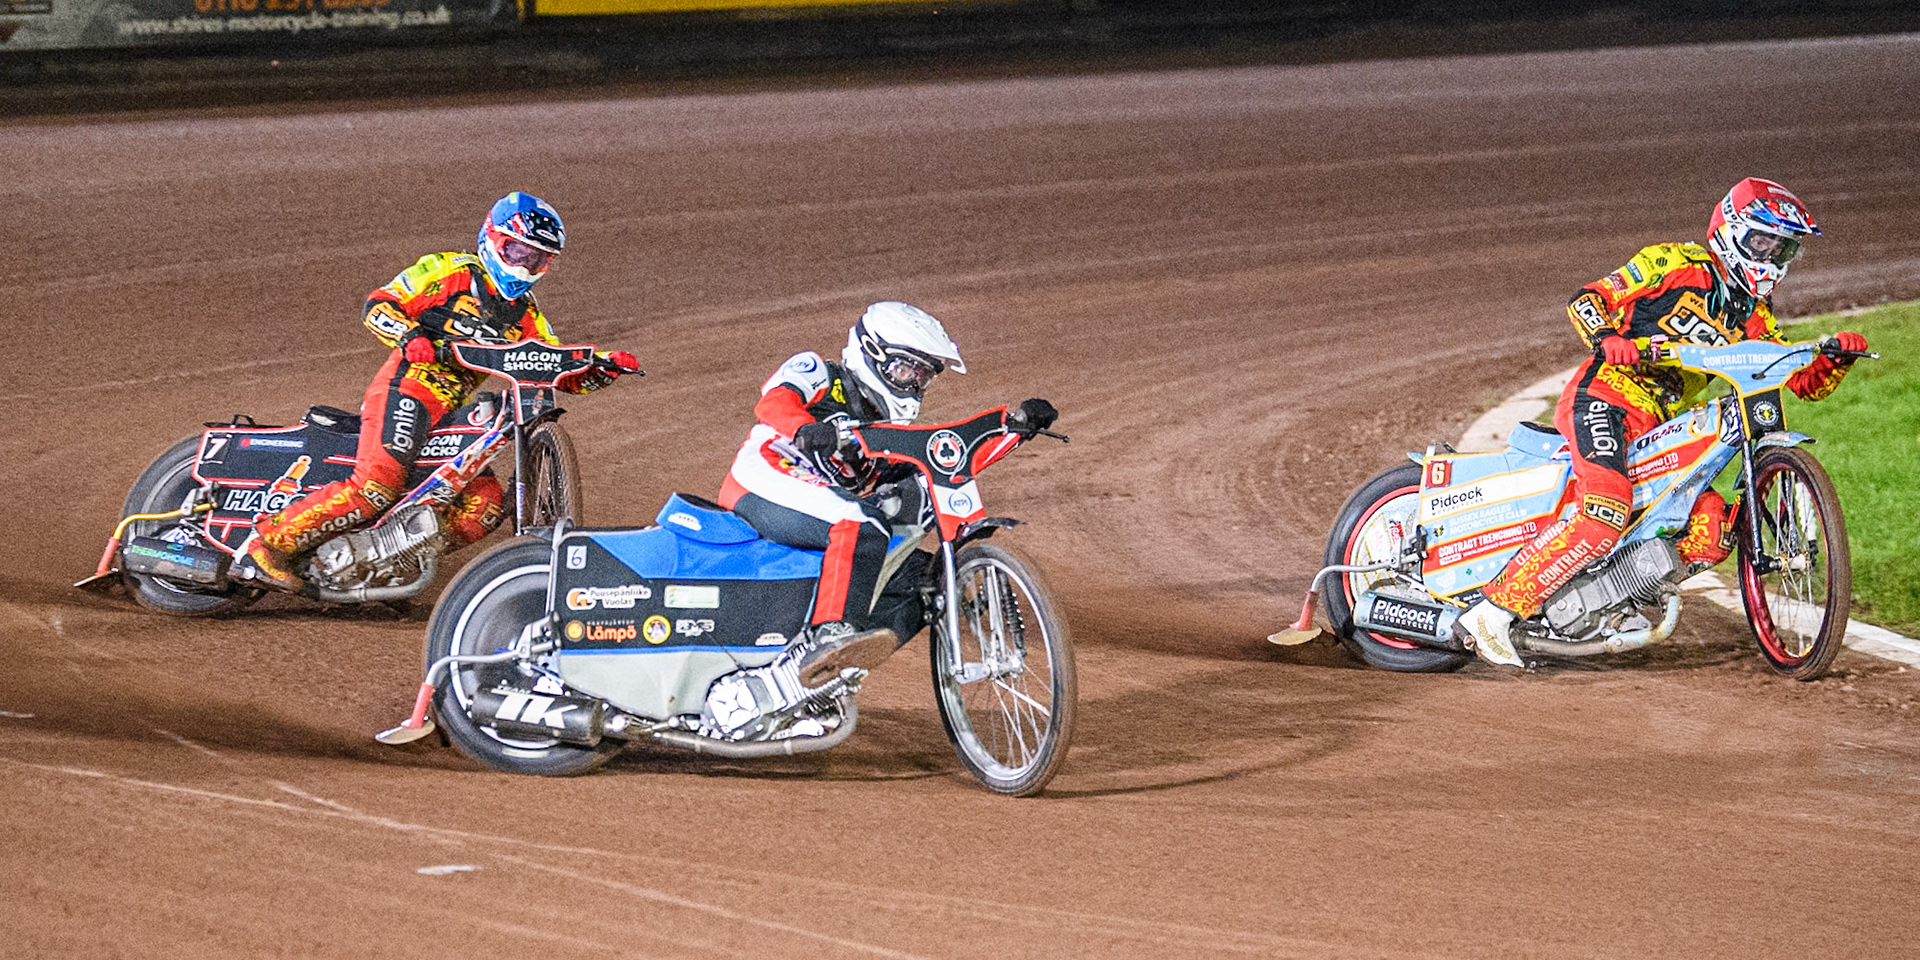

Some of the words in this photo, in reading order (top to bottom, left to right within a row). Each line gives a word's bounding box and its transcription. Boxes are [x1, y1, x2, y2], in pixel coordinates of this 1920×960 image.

[1575, 301, 1607, 329] JCB
[503, 351, 562, 363] HAGON
[503, 361, 562, 373] SHOCKS
[1703, 353, 1746, 367] CONTRACT
[392, 398, 416, 453] ignite
[1583, 400, 1618, 457] ignite
[204, 437, 228, 460] 7
[420, 446, 460, 457] OCKS
[427, 434, 463, 446] GON
[1431, 462, 1445, 485] 6
[223, 489, 307, 514] HAG
[1431, 487, 1483, 511] Pidcock
[1587, 504, 1626, 527] JCB
[1438, 538, 1478, 558] CONTRACT
[1477, 526, 1523, 546] TRENCHING
[571, 548, 582, 567] 6
[1537, 538, 1594, 587] CONTRACT
[604, 598, 633, 606] Vuolas
[1374, 599, 1437, 625] Pidcock
[586, 624, 637, 643] Lämpö
[1372, 613, 1435, 632] MOTORCYCLES
